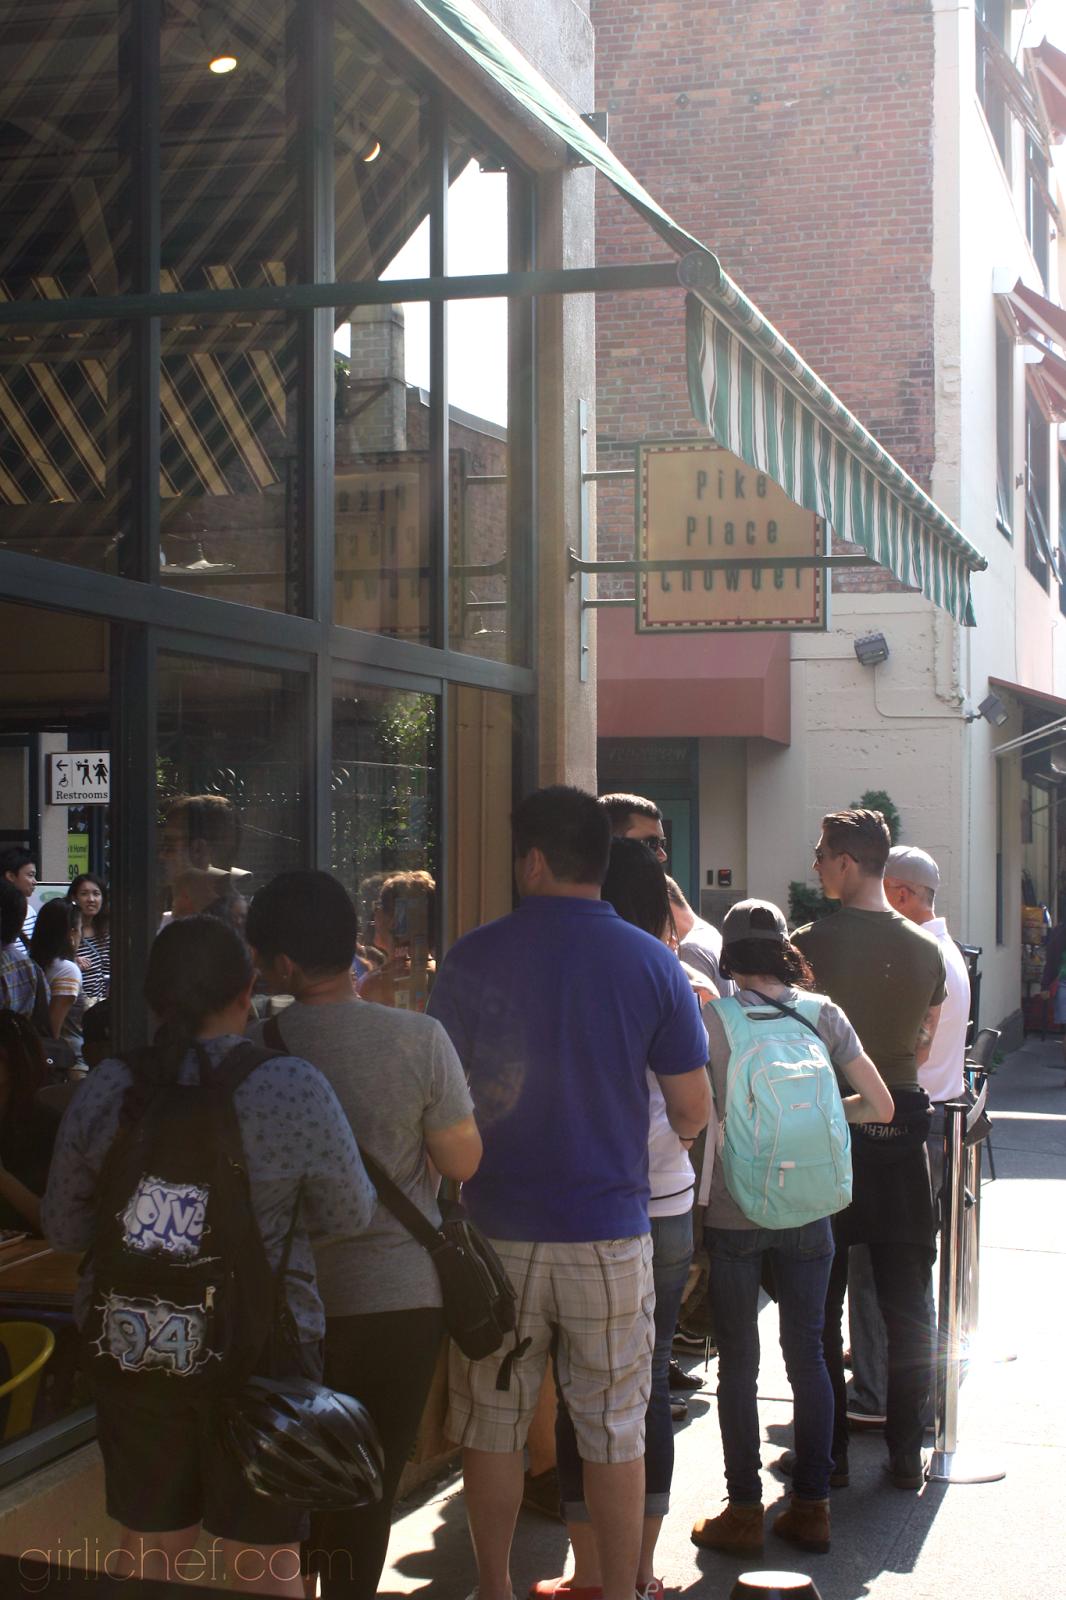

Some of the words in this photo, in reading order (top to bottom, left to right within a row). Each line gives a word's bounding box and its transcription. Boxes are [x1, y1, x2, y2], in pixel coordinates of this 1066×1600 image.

[697, 469, 767, 500] Pike
[687, 515, 779, 546] Place
[56, 790, 108, 800] Restrooms
[74, 844, 88, 853] Home!
[111, 1309, 199, 1371] 94
